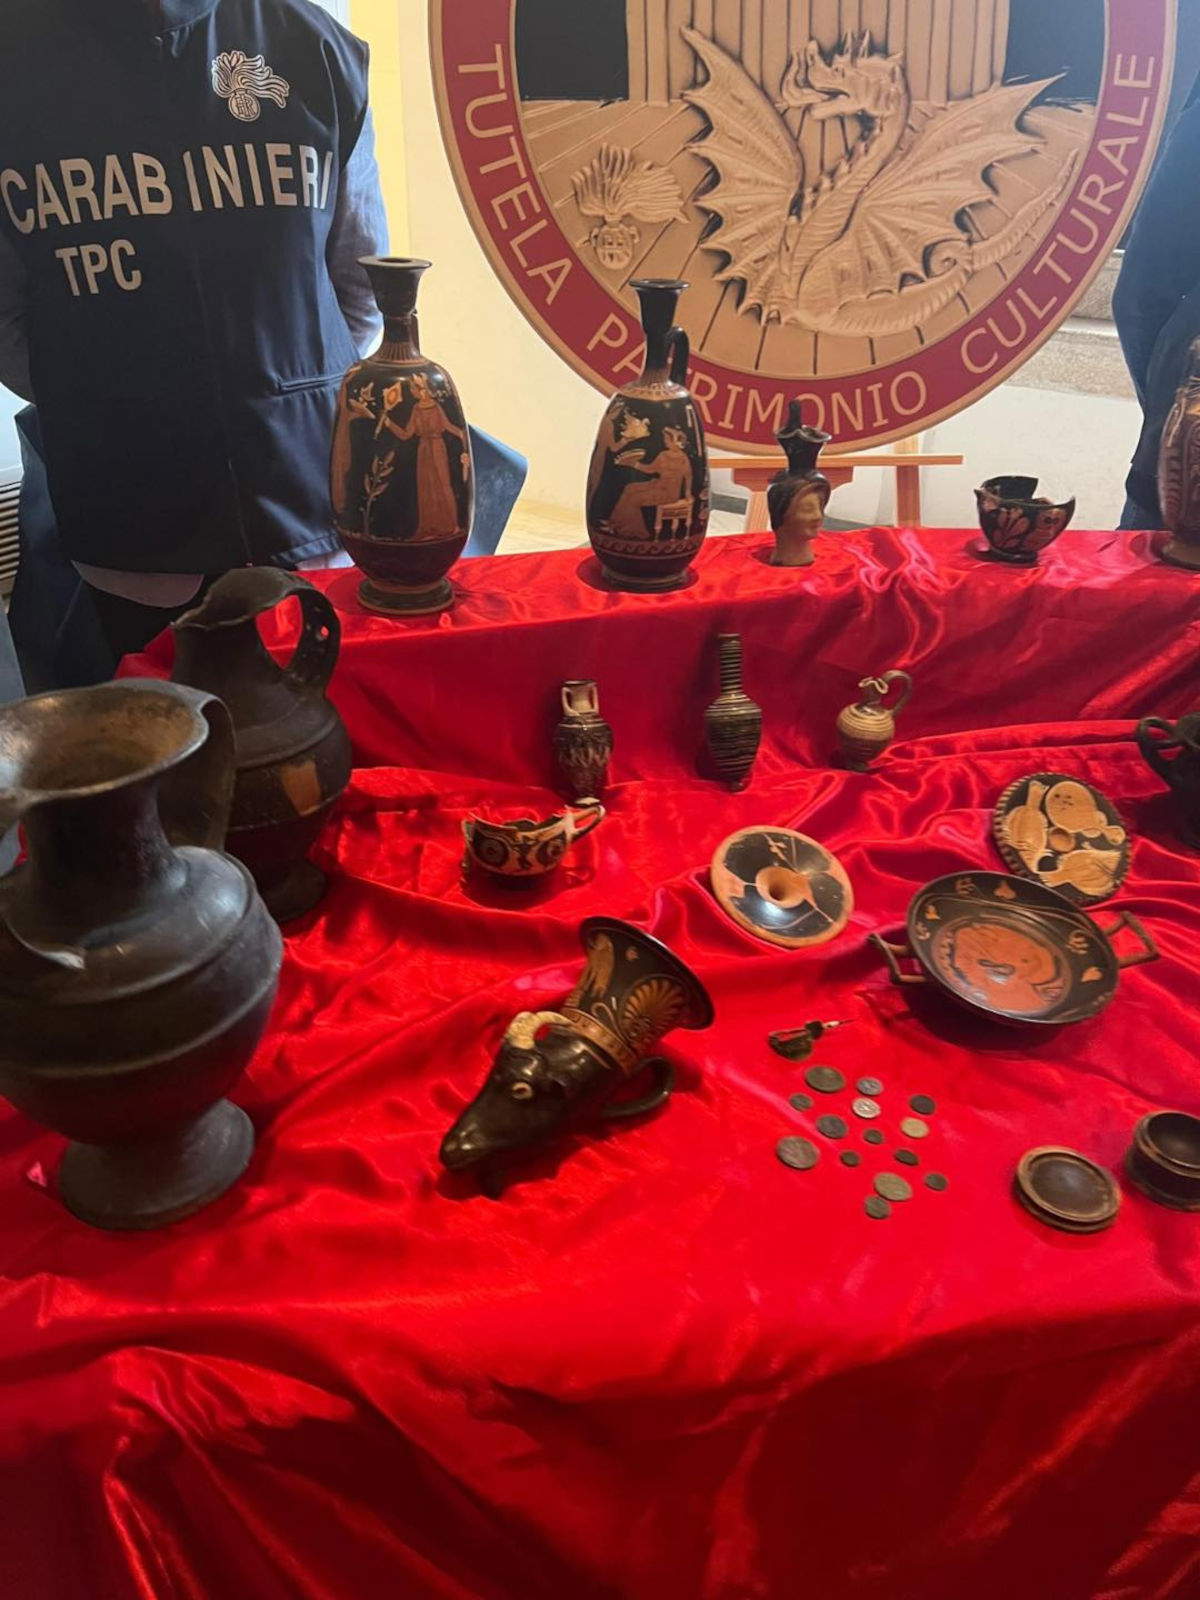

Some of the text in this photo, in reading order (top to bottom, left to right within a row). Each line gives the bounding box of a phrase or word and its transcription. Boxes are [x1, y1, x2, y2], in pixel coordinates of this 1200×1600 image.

[55, 239, 143, 297] TPC
[457, 43, 1155, 437] TUTELA PARIMONIO CULTURALE
